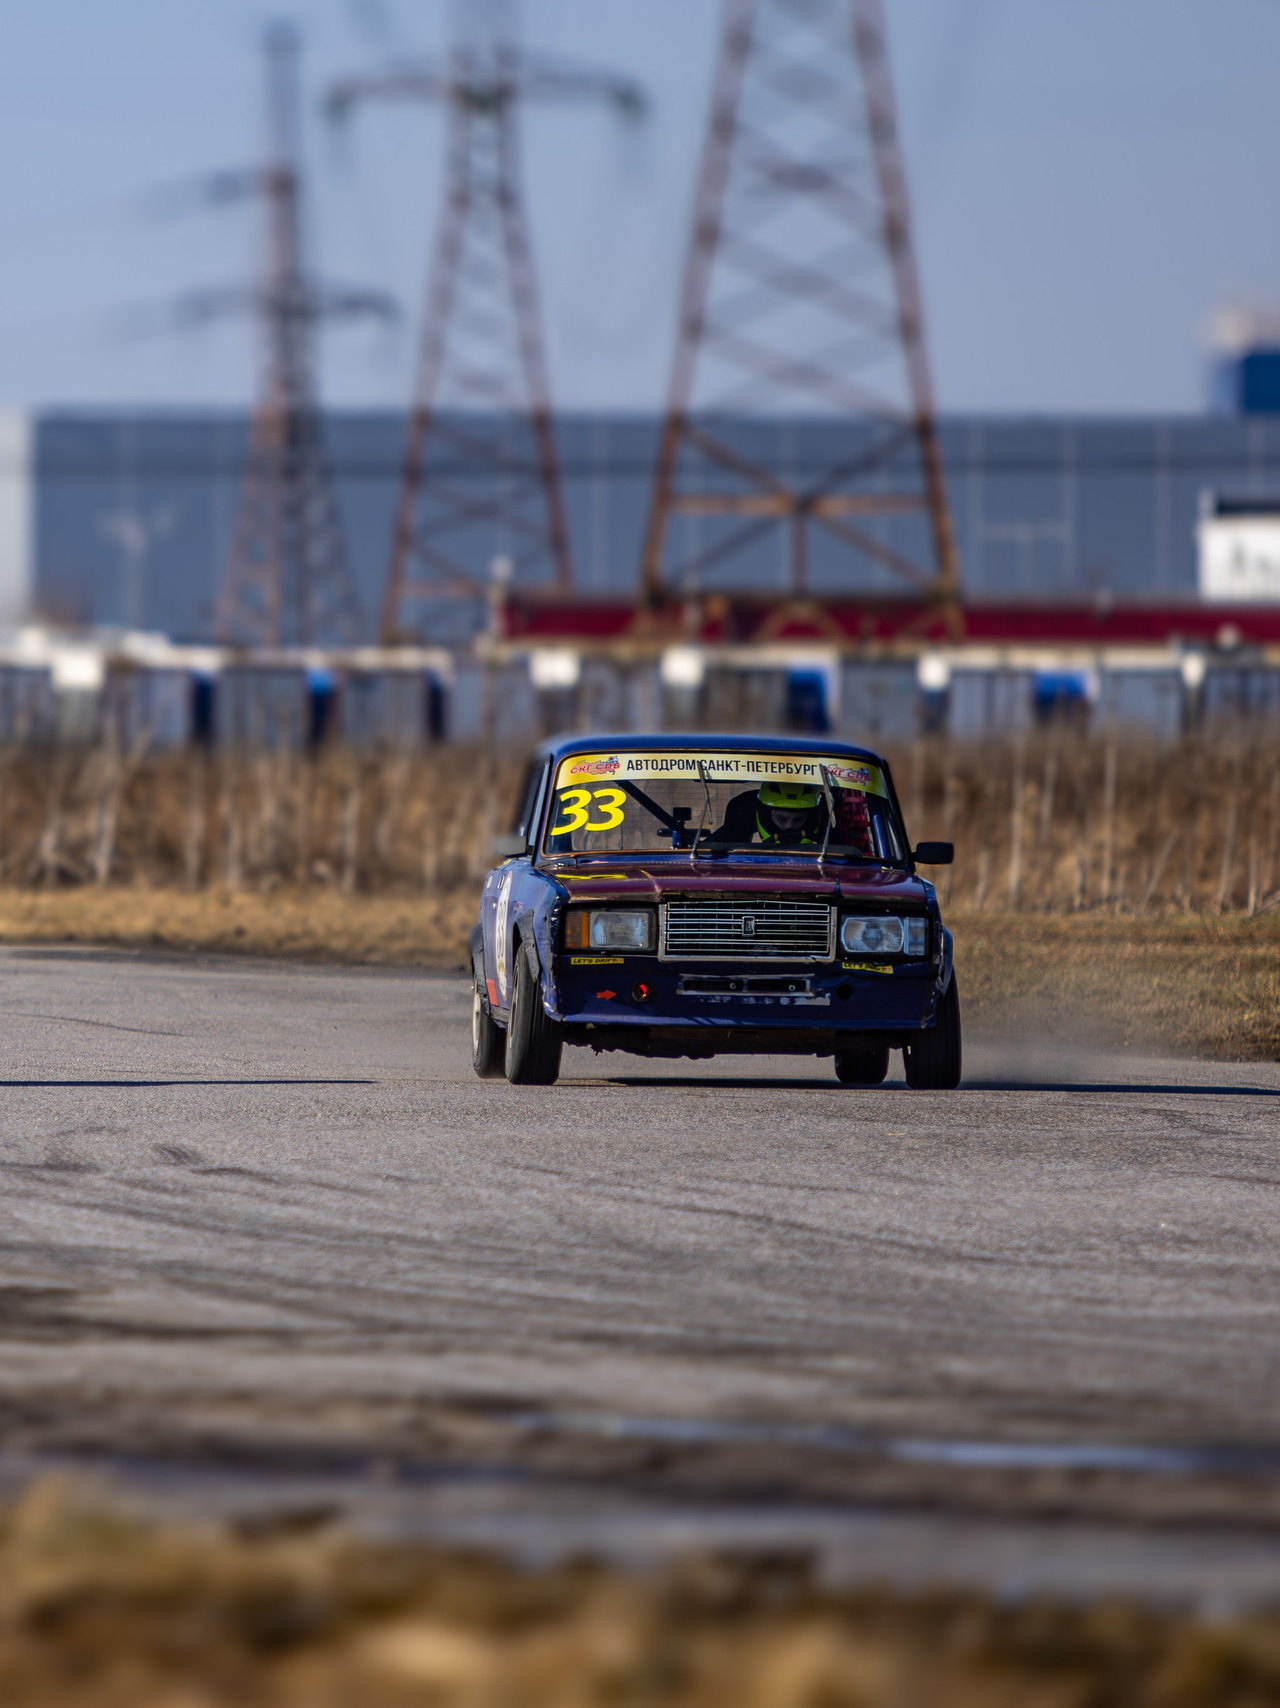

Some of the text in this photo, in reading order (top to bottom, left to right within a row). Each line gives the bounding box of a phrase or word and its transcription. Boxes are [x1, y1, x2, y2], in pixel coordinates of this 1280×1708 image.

[626, 758, 818, 776] АВТОДРОМ САНКТ-ПЕТЕРБУРГ
[550, 788, 627, 836] 33
